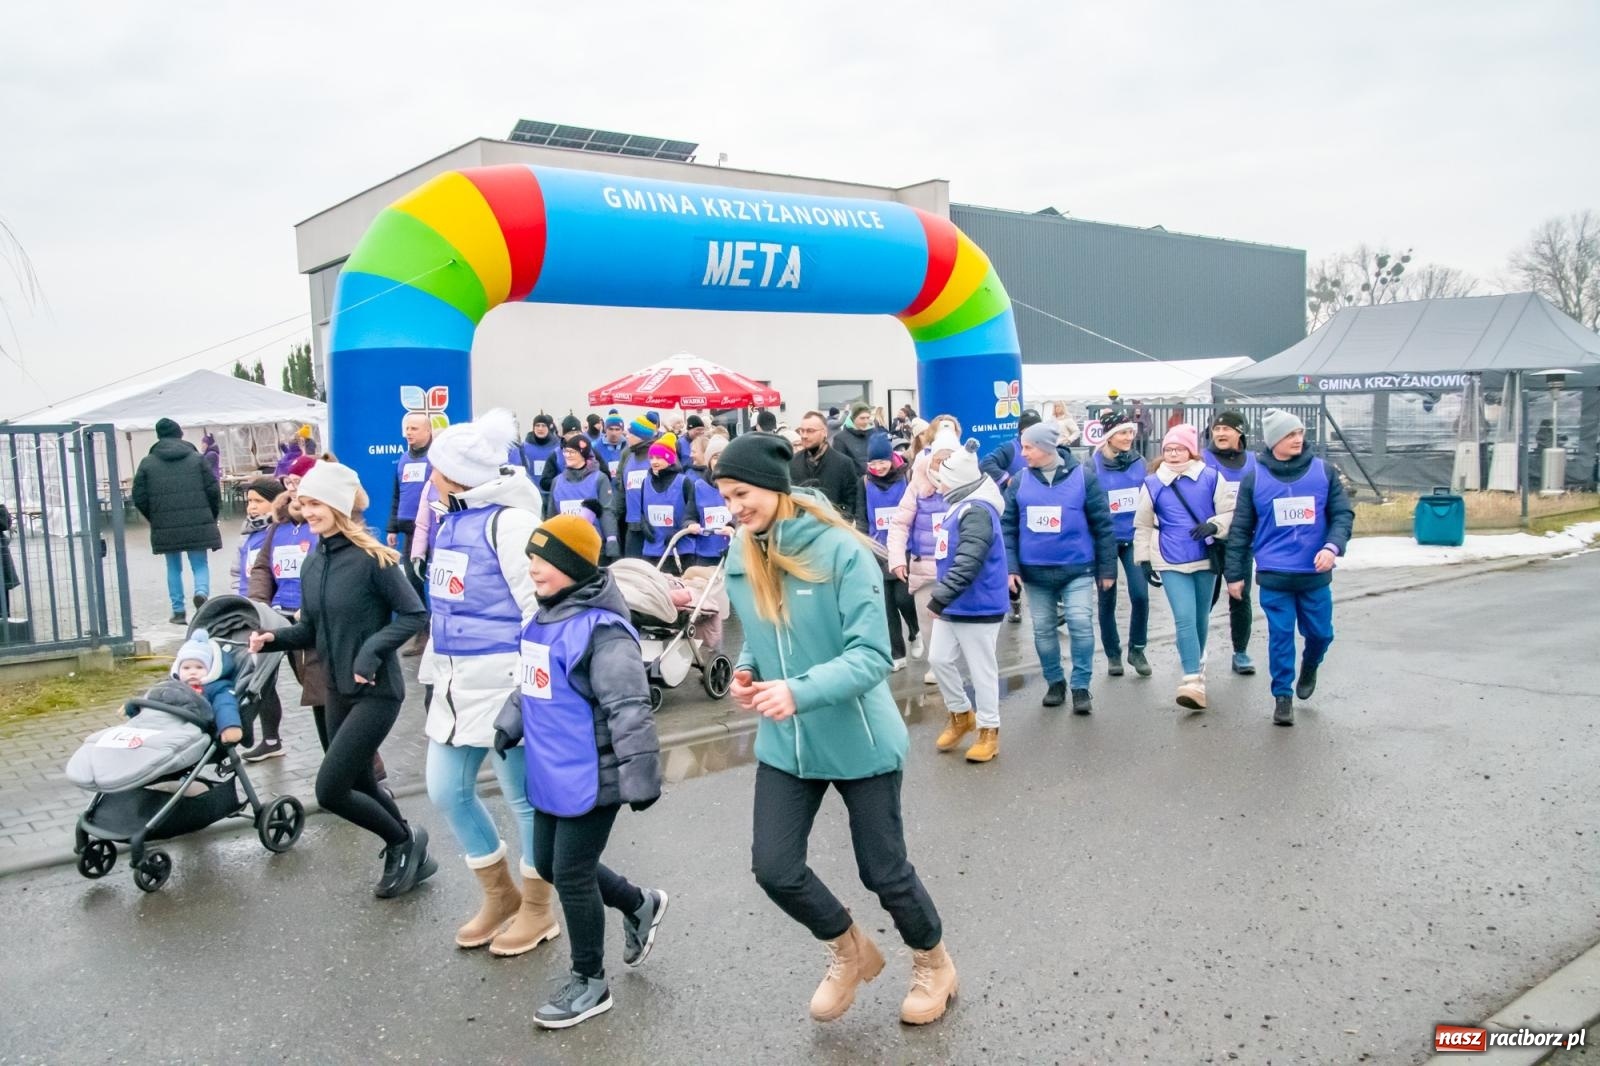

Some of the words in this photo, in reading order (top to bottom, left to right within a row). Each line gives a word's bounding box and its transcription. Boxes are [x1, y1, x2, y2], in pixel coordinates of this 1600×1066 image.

[603, 187, 698, 216] GMINA
[702, 197, 885, 230] KRZYŻANOWICE
[702, 240, 800, 290] META
[1319, 377, 1362, 391] GMINA
[1365, 373, 1481, 389] KRZYŻANOWIC
[683, 398, 705, 406] WARKA
[971, 424, 998, 433] GMINA
[1090, 427, 1103, 438] 20
[368, 444, 405, 454] GMINA
[1283, 508, 1304, 520] 108
[1036, 515, 1049, 526] 49
[280, 558, 297, 572] 124
[432, 568, 453, 587] 107
